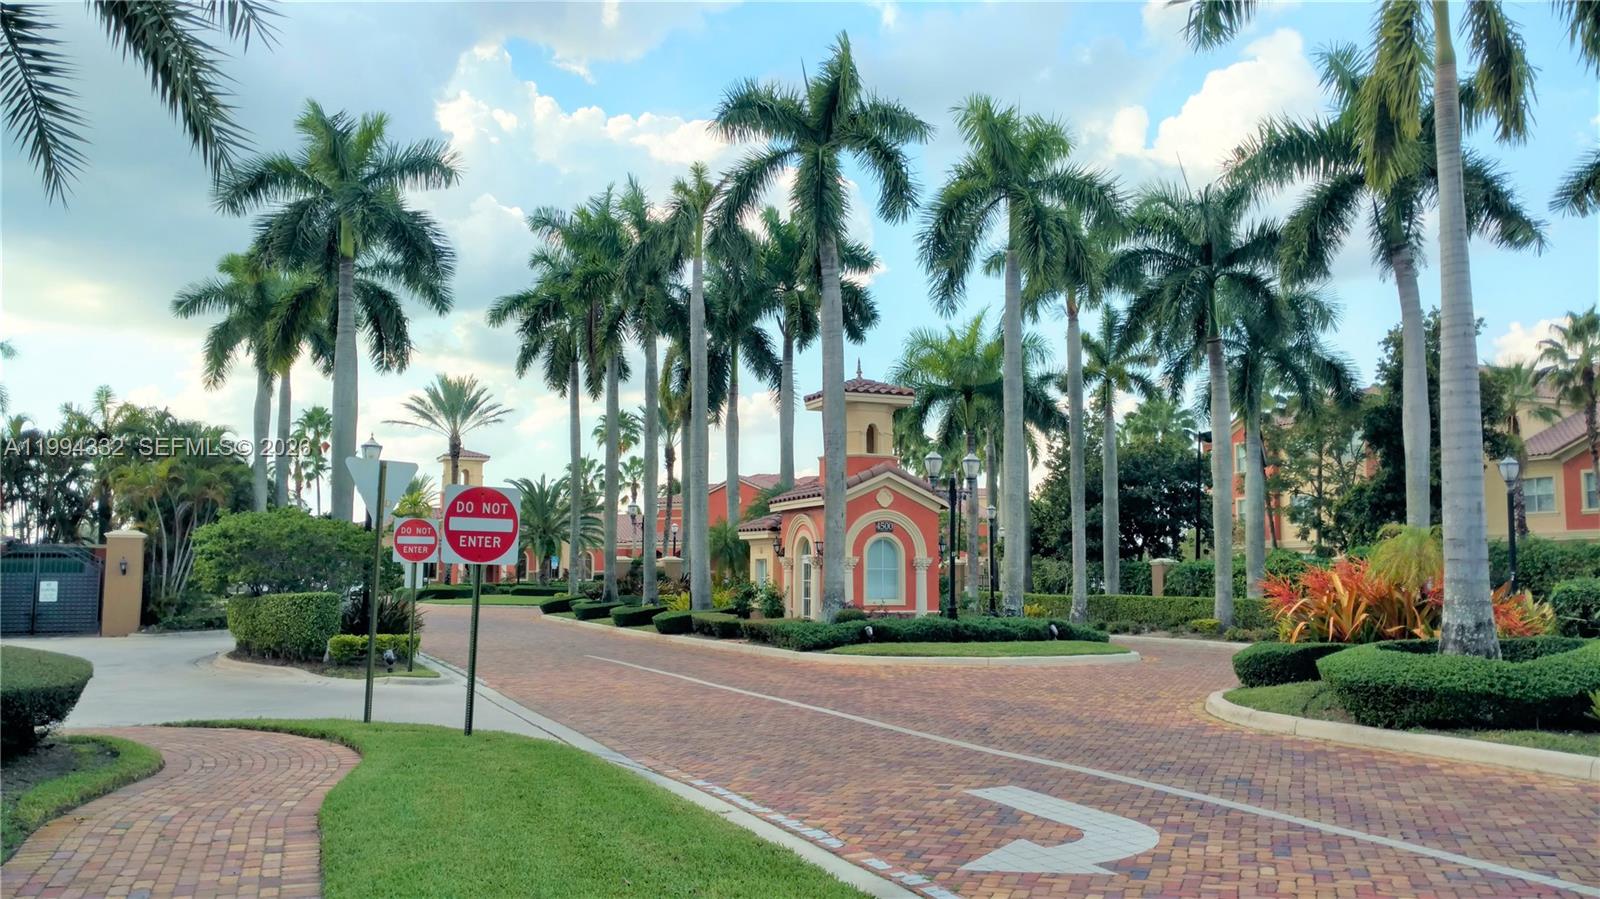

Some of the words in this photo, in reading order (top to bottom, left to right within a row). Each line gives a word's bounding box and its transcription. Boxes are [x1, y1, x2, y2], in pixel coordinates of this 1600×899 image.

[456, 501, 474, 513] DO
[482, 503, 508, 515] NOT
[401, 527, 412, 535] DO
[416, 527, 431, 535] NOT
[876, 521, 894, 532] 4500
[459, 536, 501, 548] ENTER
[403, 546, 428, 554] ENTER
